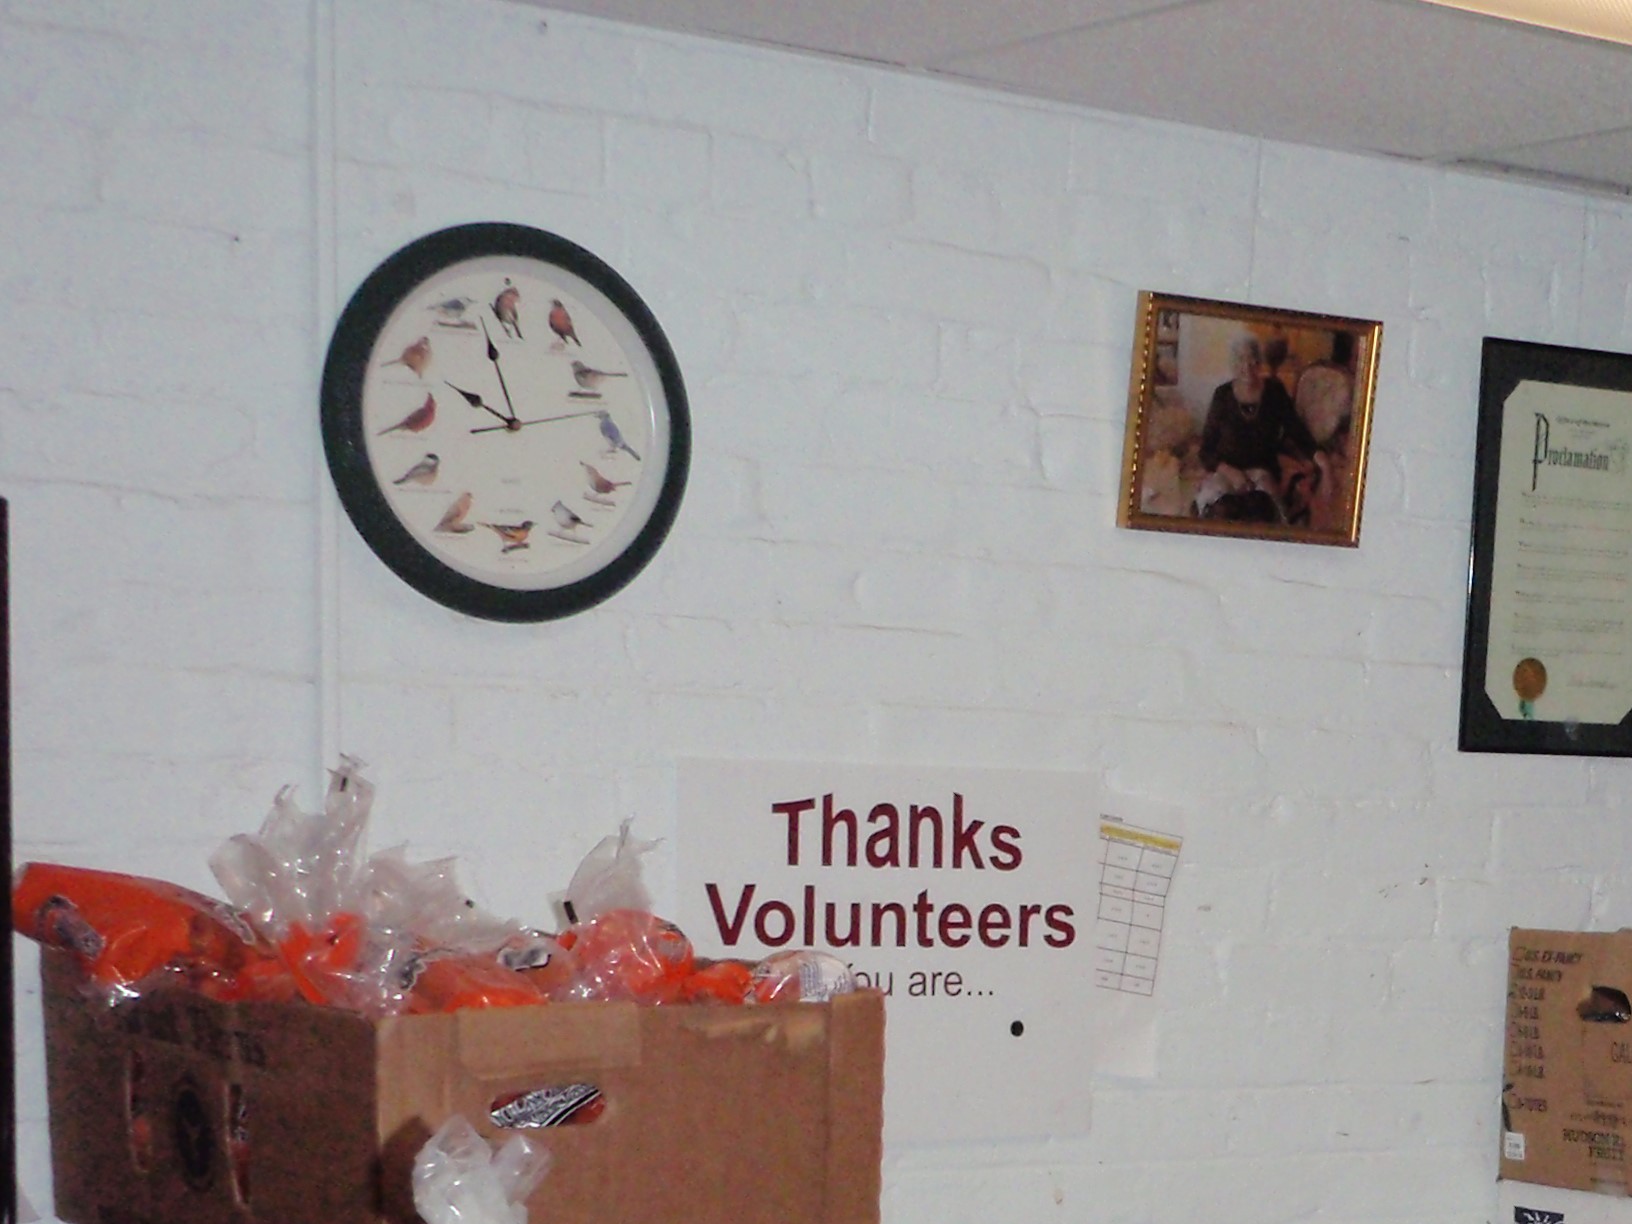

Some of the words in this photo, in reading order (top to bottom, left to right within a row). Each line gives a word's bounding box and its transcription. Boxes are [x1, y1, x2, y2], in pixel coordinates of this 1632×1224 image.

[1532, 412, 1609, 491] Proclamation
[771, 792, 1023, 871] Thanks
[704, 883, 1077, 949] Volunteers
[848, 963, 893, 997] ou
[909, 968, 995, 998] are...
